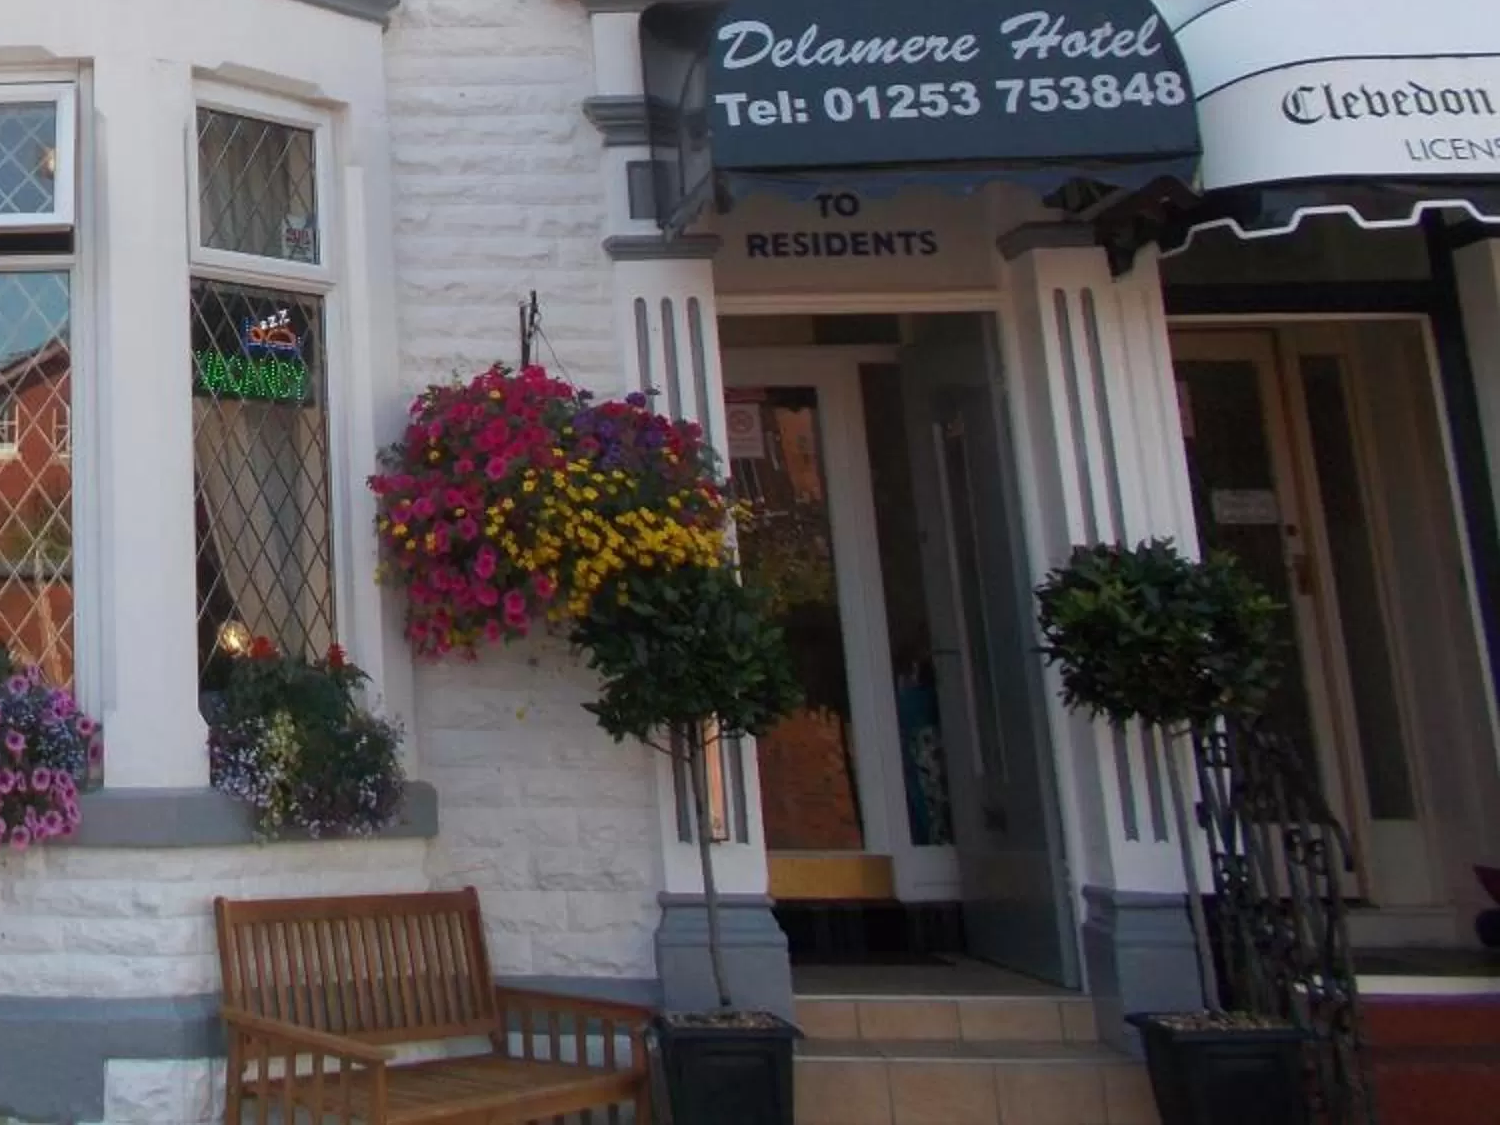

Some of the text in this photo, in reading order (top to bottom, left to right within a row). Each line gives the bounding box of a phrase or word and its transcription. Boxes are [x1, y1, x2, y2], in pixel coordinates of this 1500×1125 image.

[716, 9, 1163, 70] Delamere Hotel
[714, 70, 1187, 126] Tel: 01253 753848
[1281, 79, 1497, 125] Clevedon
[813, 191, 861, 219] TO
[745, 229, 939, 259] RESIDENTS
[195, 349, 306, 407] VACANCY
